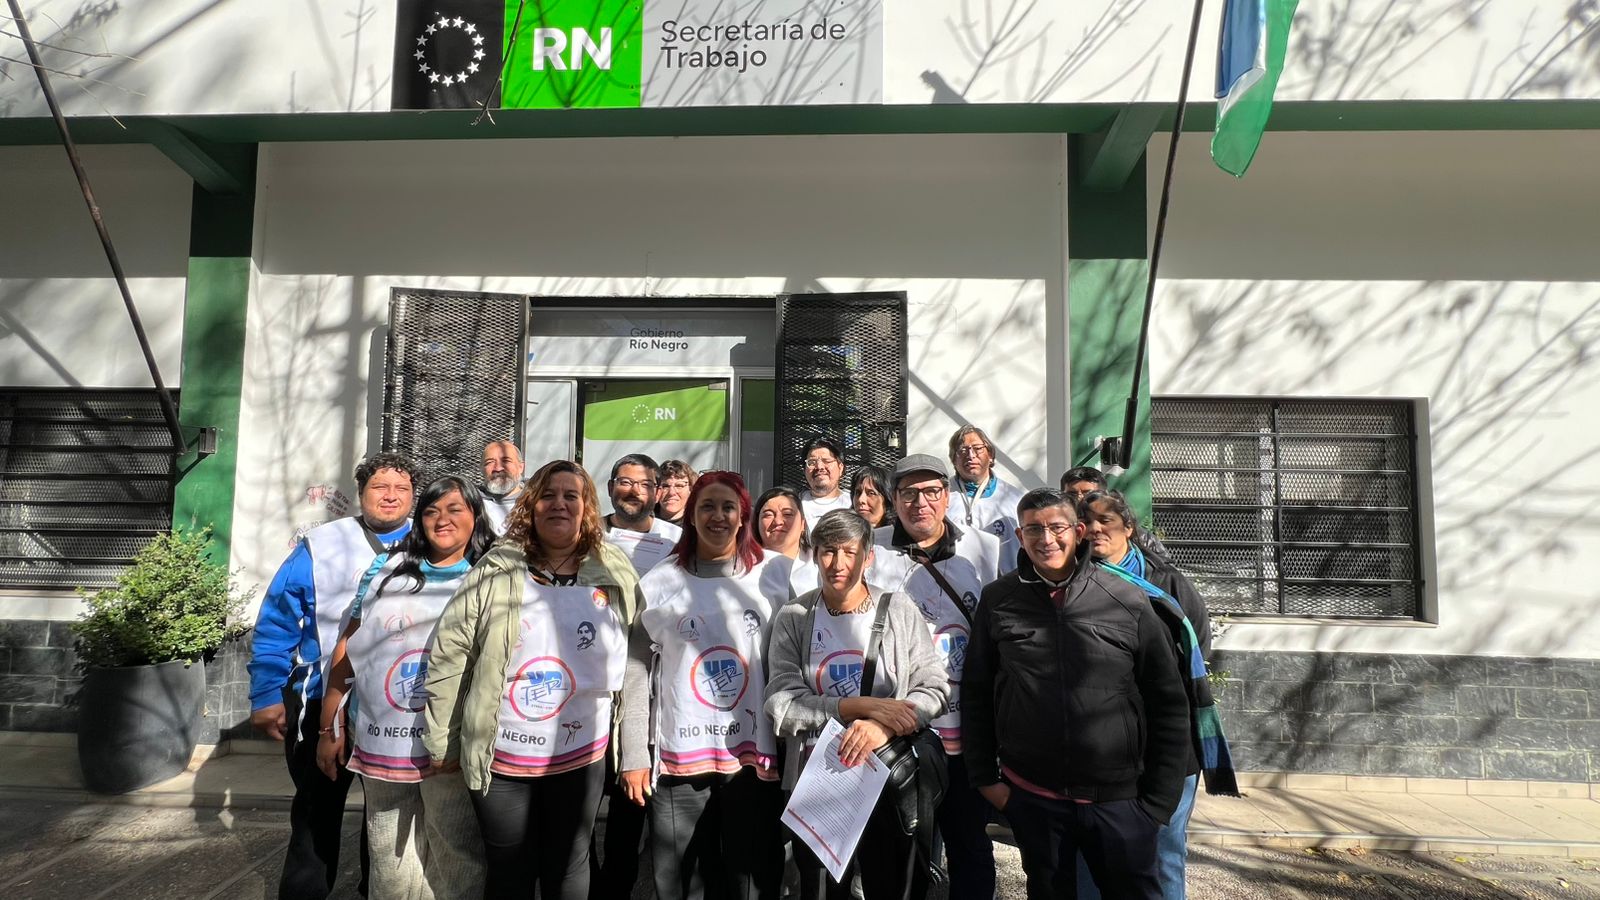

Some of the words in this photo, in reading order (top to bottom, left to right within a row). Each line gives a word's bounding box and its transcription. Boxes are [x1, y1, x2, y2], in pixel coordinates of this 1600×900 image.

[660, 19, 804, 43] Secretaría
[810, 18, 846, 41] de
[532, 26, 612, 71] RN
[660, 43, 767, 73] Trabajo
[630, 327, 684, 338] Gobierno
[629, 338, 649, 350] Río
[651, 339, 688, 352] Negro
[655, 407, 676, 420] RN
[502, 728, 547, 746] NEGRO
[680, 724, 700, 738] RÍO
[704, 722, 741, 736] NEGRO
